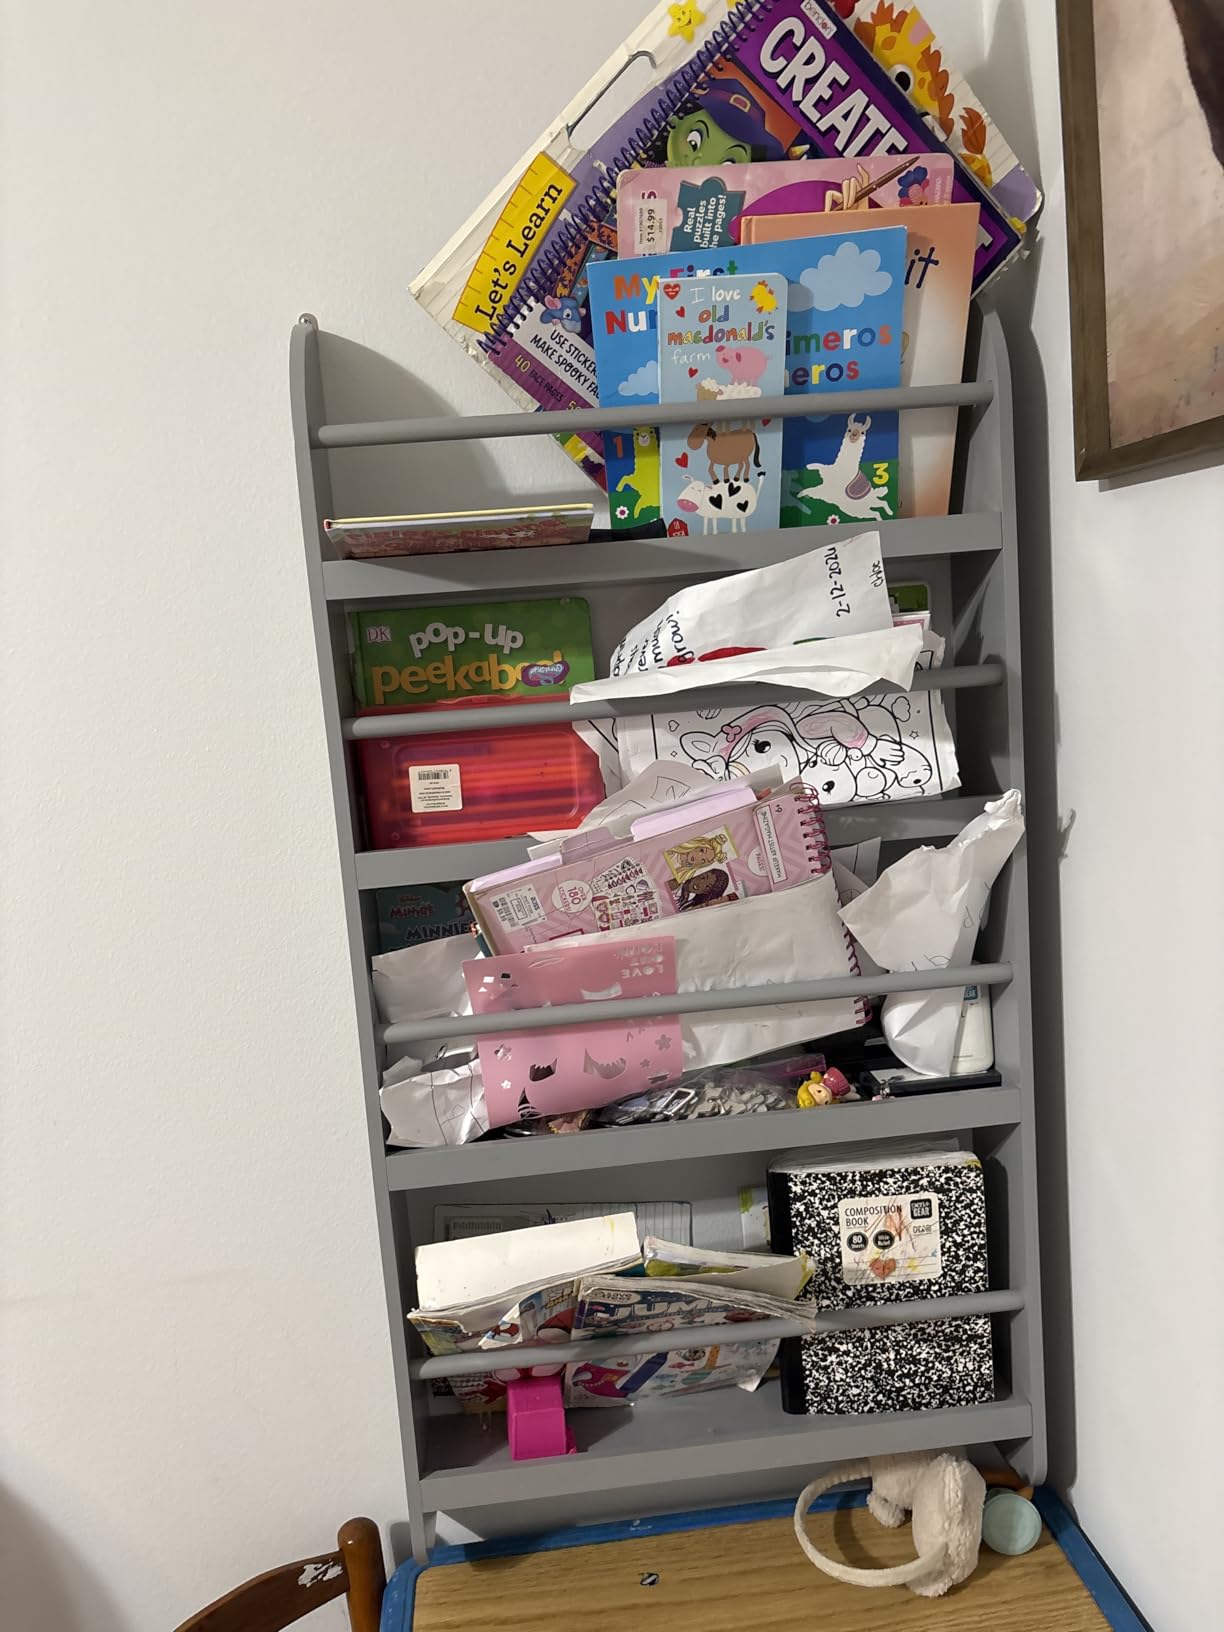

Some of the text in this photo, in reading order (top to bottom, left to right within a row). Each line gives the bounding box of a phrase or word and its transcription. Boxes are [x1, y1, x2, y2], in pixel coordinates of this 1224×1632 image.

[683, 207, 696, 233] Real
[693, 200, 707, 243] puzzles
[700, 196, 718, 248] built into
[713, 194, 726, 232] pages!
[646, 208, 656, 243] $14.99
[475, 183, 563, 322] Let's Learn
[690, 287, 704, 304] I
[711, 285, 741, 302] love
[698, 304, 730, 324] old
[549, 330, 569, 348] USE
[667, 320, 775, 346] macdonald's
[530, 334, 559, 361] MAKE
[553, 354, 590, 387] SPOOKY
[672, 348, 711, 365] farm
[512, 353, 532, 373] 40
[542, 381, 565, 403] PAGES
[614, 436, 623, 458] 1
[872, 462, 889, 485] 3
[366, 627, 391, 643] DK
[566, 886, 581, 905] 180
[405, 921, 470, 940] MINNIE
[845, 1204, 902, 1216] COMPOSITION
[913, 1207, 930, 1217] GEAR
[846, 1217, 869, 1227] BOOK
[852, 1235, 863, 1244] 80
